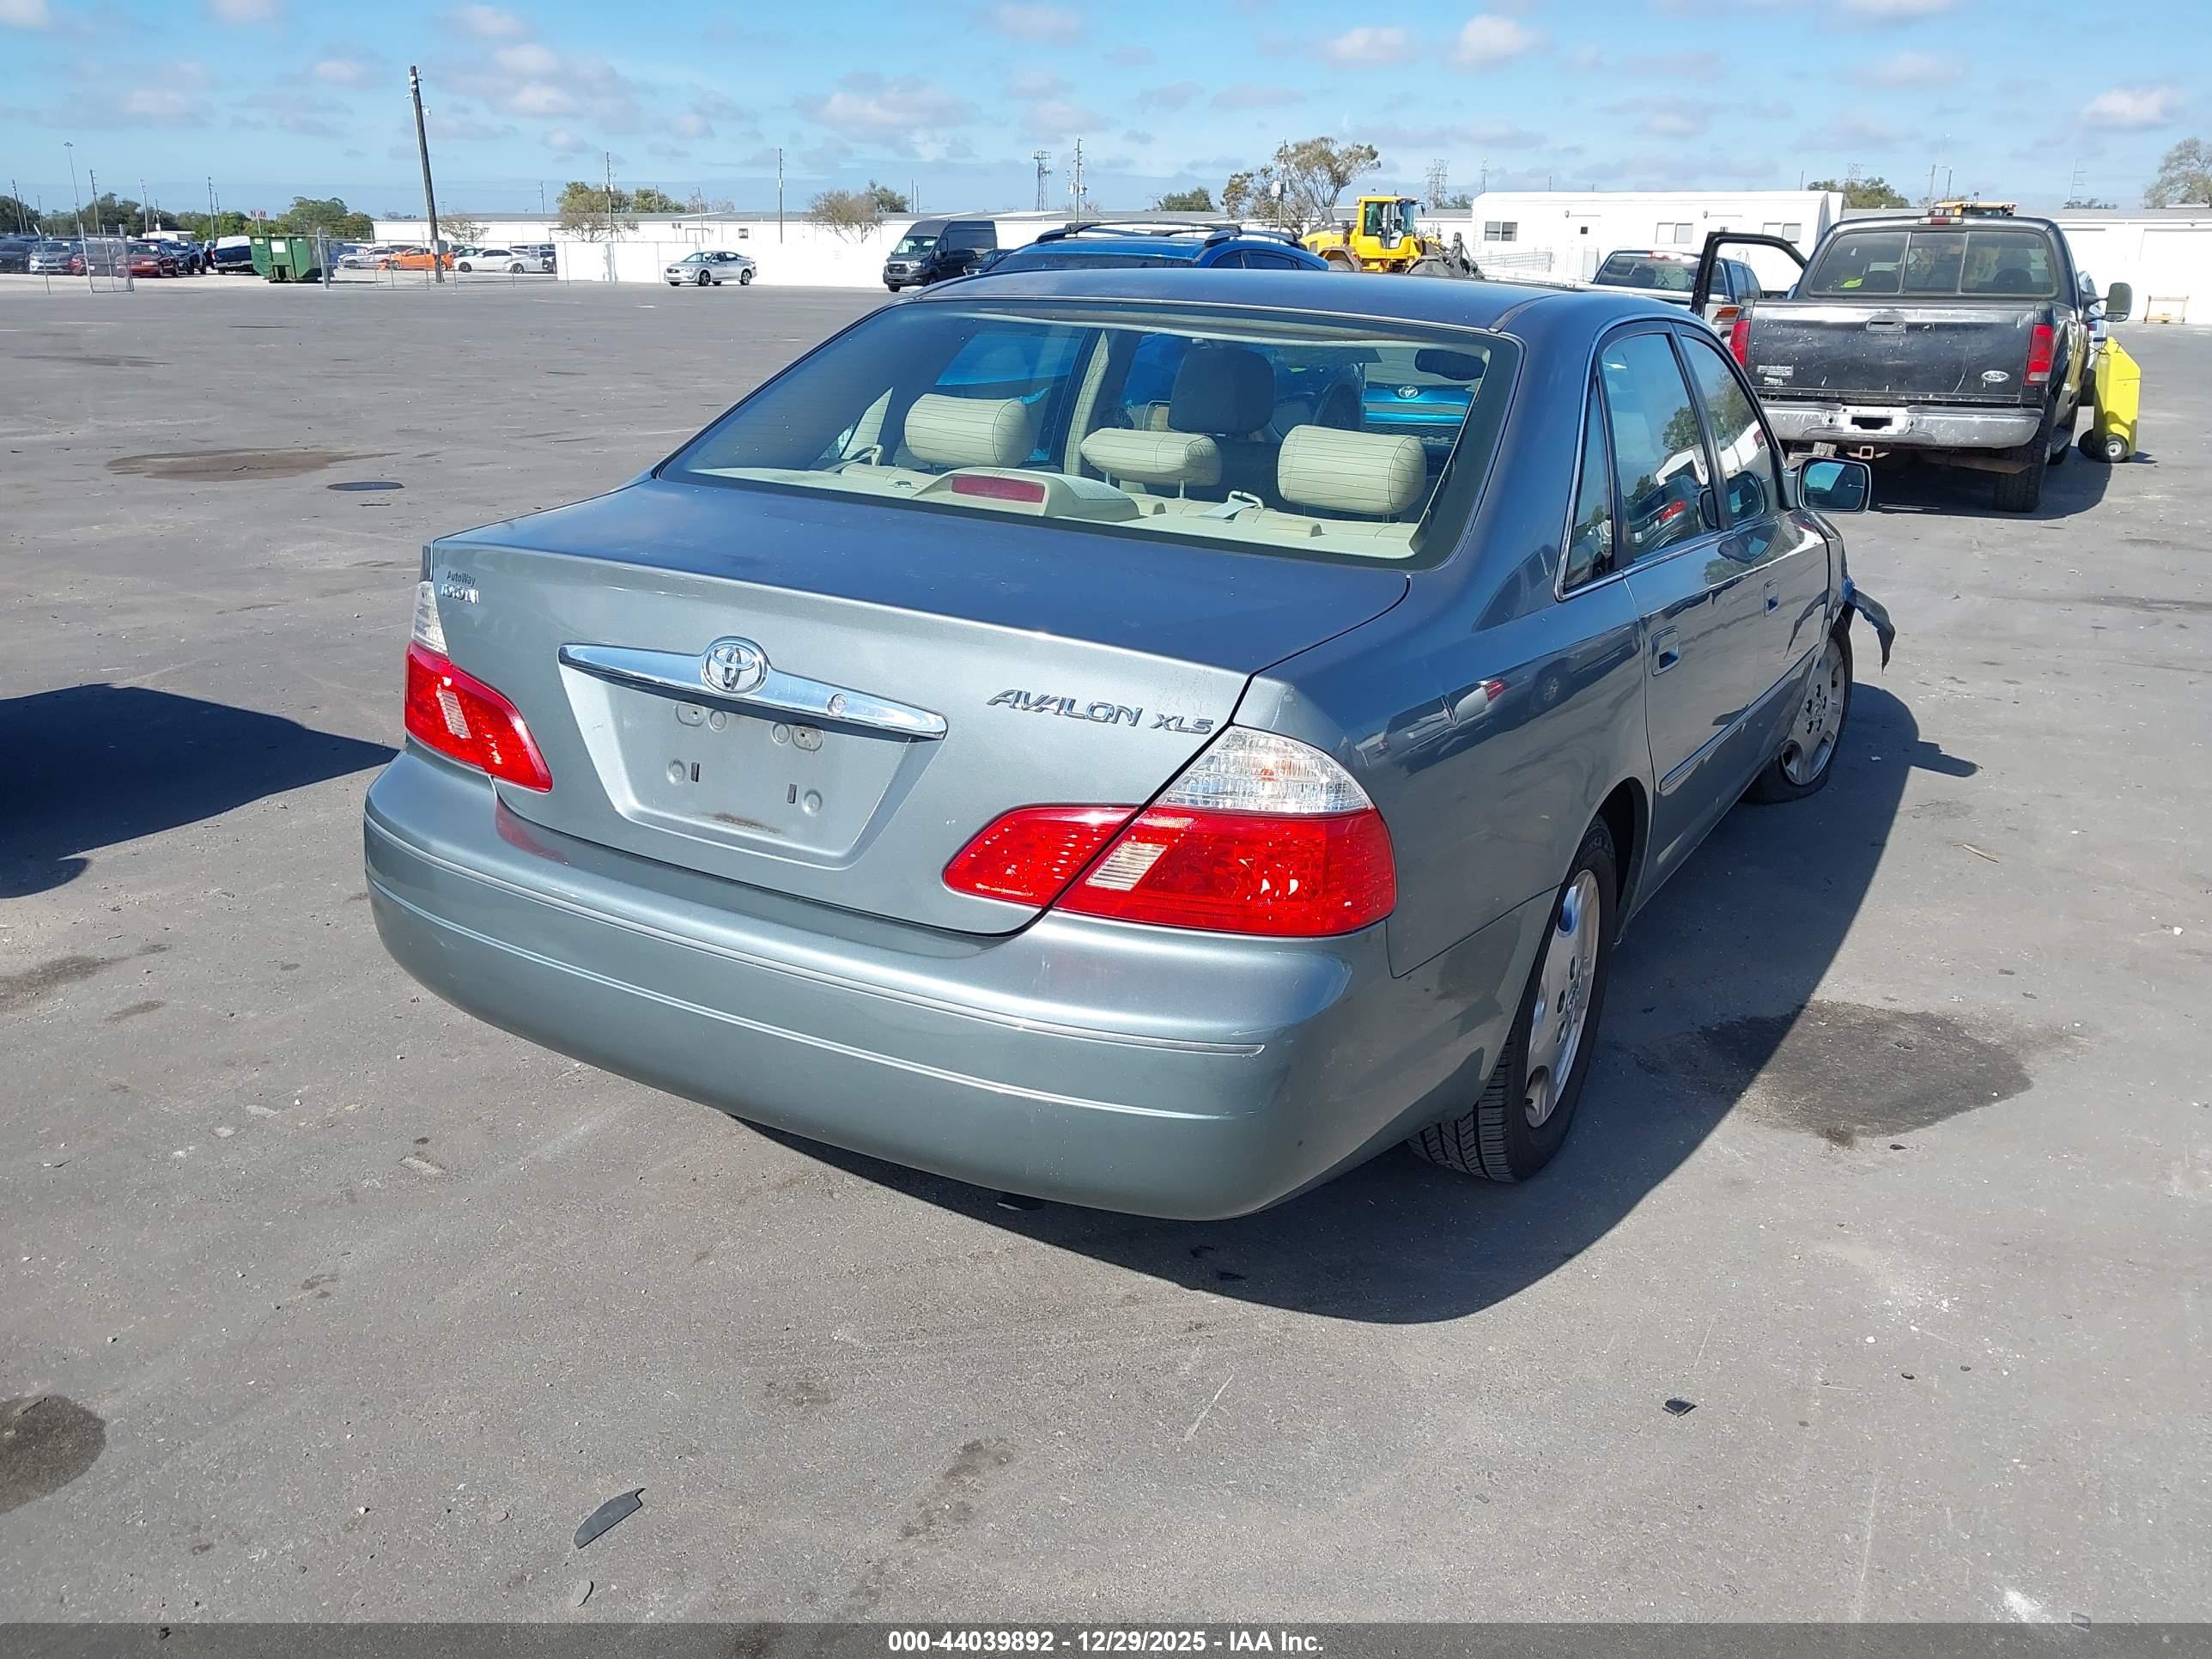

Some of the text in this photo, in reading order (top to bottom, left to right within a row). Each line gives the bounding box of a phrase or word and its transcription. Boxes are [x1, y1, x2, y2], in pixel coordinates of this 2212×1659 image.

[447, 569, 477, 587] AutoWay
[987, 689, 1214, 735] AVALON XLS
